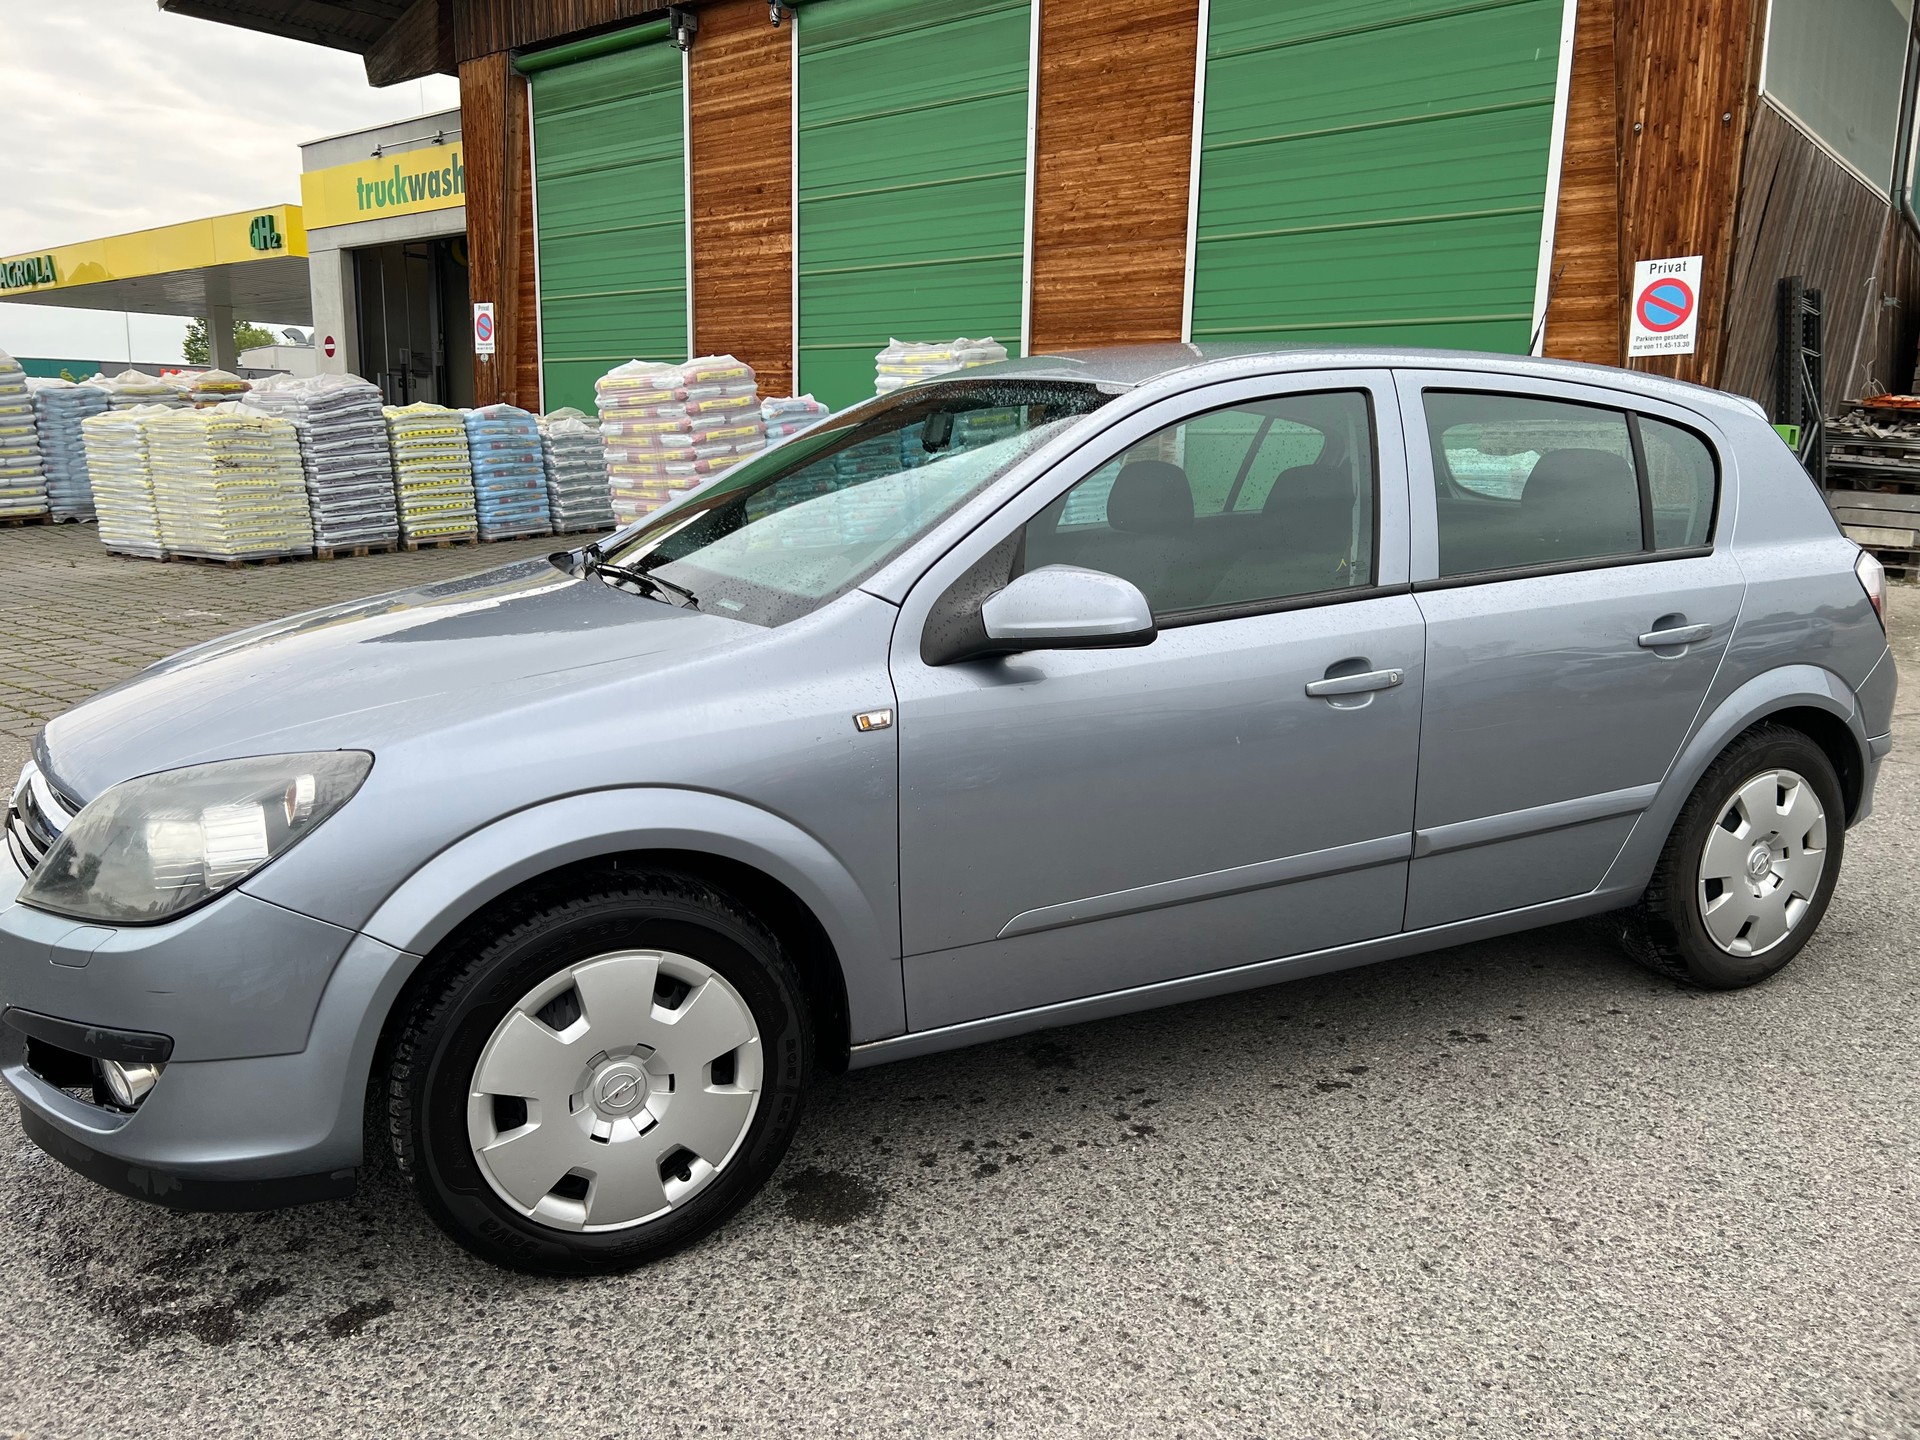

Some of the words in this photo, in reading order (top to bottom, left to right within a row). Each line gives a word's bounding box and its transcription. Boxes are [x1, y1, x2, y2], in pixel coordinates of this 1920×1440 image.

[357, 153, 465, 210] truckwash
[0, 255, 56, 288] AGROLA
[1649, 261, 1687, 274] Privat
[1655, 341, 1690, 349] 11.45-13.30
